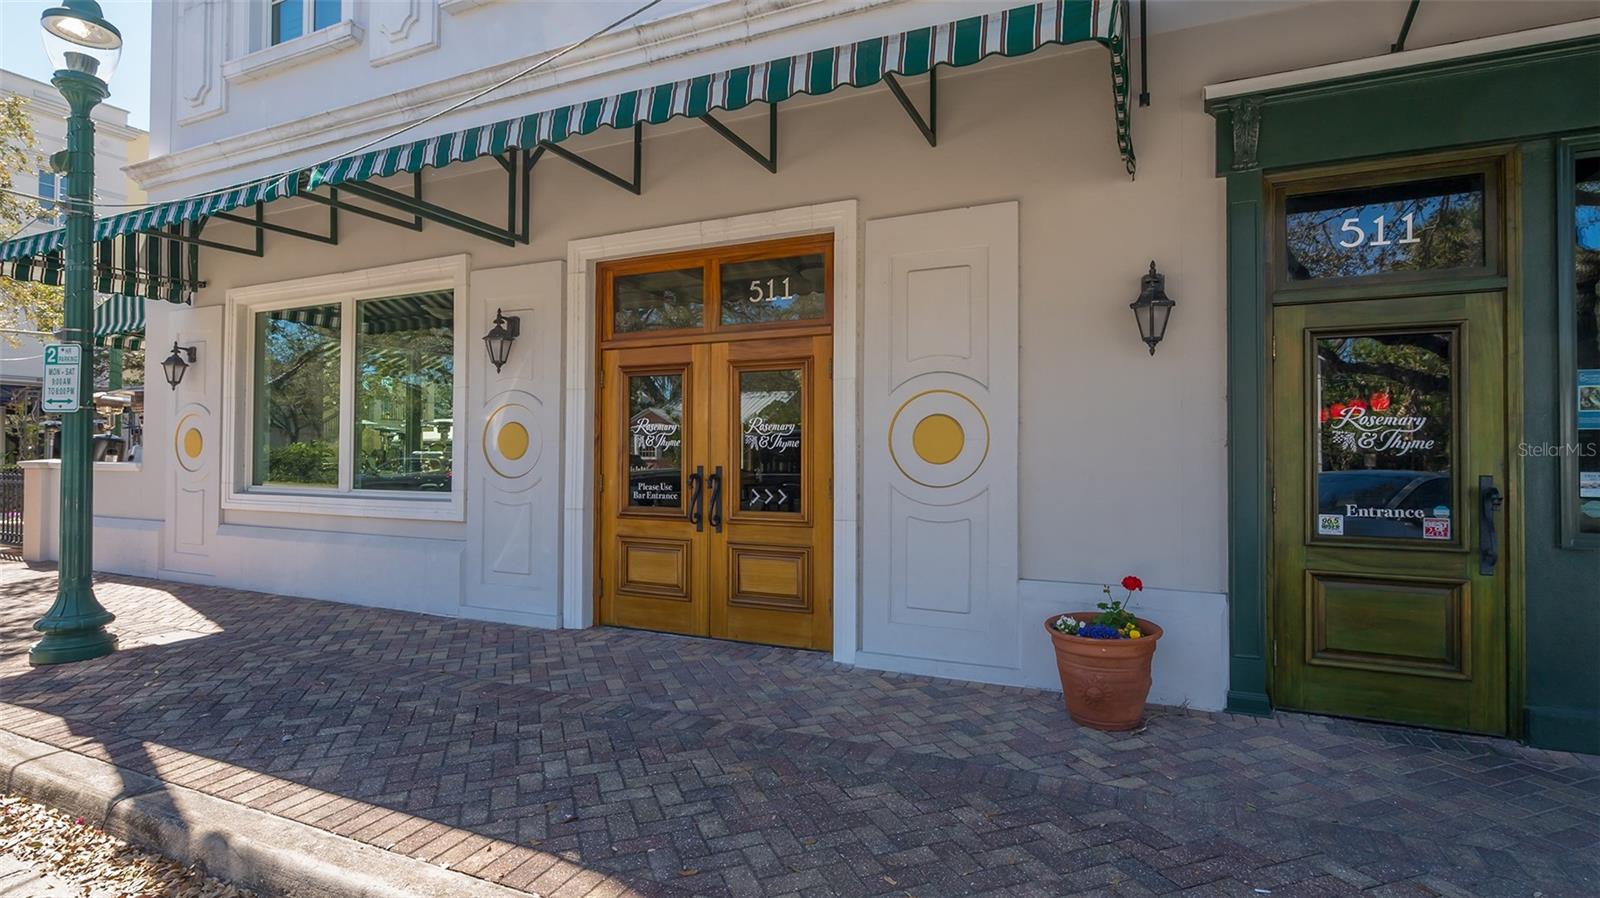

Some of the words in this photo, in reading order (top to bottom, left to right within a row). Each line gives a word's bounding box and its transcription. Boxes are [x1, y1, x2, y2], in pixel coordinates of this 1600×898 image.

[1340, 212, 1420, 248] 511
[749, 277, 792, 302] 511
[47, 347, 57, 363] 2
[632, 417, 678, 436] Rosemary
[745, 417, 796, 436] Rosemary
[1331, 406, 1428, 432] Rosemary
[645, 434, 656, 447] &
[654, 432, 681, 451] Thyme
[758, 434, 768, 448] &
[767, 432, 800, 453] Thyme
[1357, 431, 1376, 448] &
[1374, 428, 1435, 456] Thyme
[633, 491, 645, 500] Bar
[647, 491, 678, 500] Entrance
[638, 482, 659, 491] Please
[660, 482, 673, 491] Use
[1346, 504, 1425, 519] Entrance
